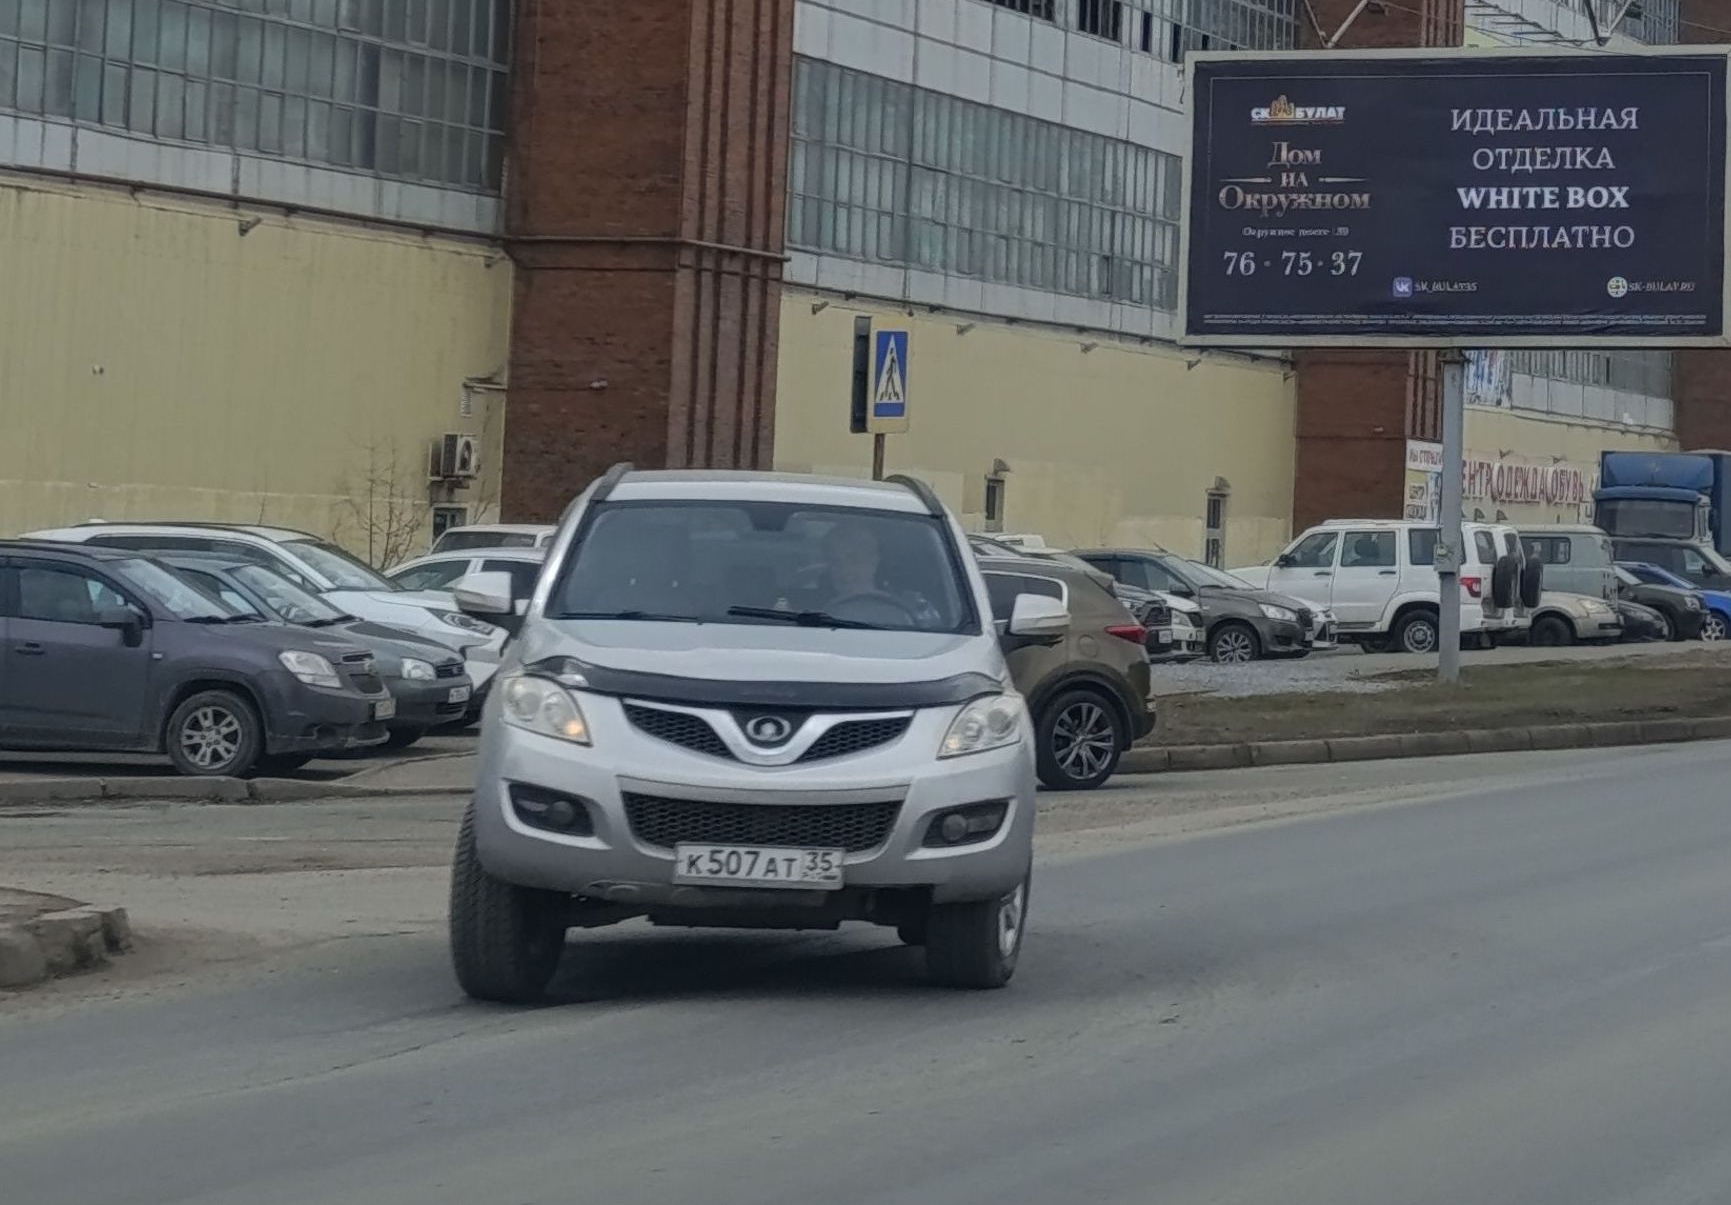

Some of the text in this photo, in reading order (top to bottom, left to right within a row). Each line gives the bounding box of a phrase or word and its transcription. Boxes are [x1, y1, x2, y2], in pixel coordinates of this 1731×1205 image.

[1295, 106, 1346, 120] БУЛАТ
[1450, 107, 1640, 135] ИДЕАЛЬНАЯ
[1266, 141, 1323, 169] Дом
[1472, 146, 1616, 174] ОТДЕЛКА
[1218, 184, 1371, 218] Окружном
[1456, 186, 1630, 210] WHITE BOX
[1449, 225, 1635, 249] БЕСПЛАТНО
[1223, 250, 1363, 276] 76 75 37
[1462, 459, 1493, 496] ЕНТР
[1496, 464, 1547, 501] ОДЕЖДА
